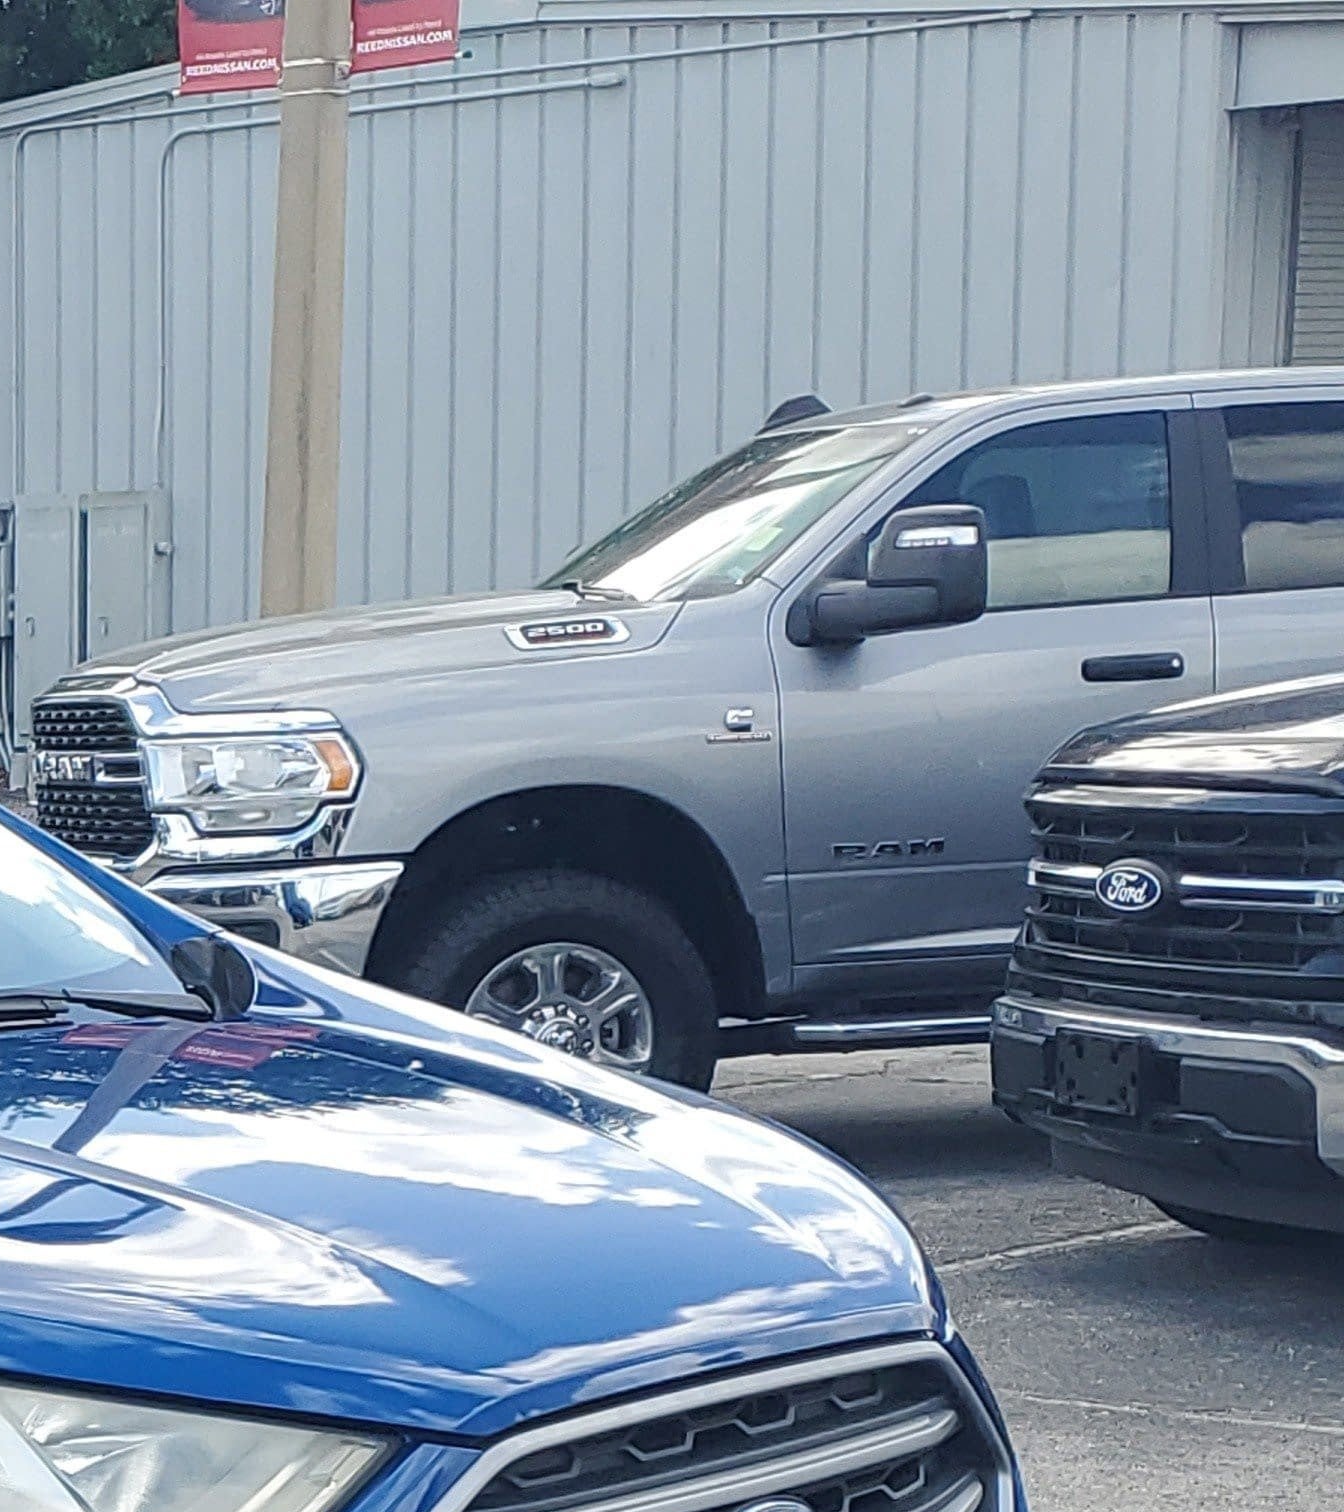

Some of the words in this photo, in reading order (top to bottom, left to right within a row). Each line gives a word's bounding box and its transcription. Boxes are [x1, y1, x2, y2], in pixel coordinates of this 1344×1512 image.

[528, 622, 605, 638] 2500
[832, 837, 945, 860] RAM
[1107, 872, 1148, 904] Ford
